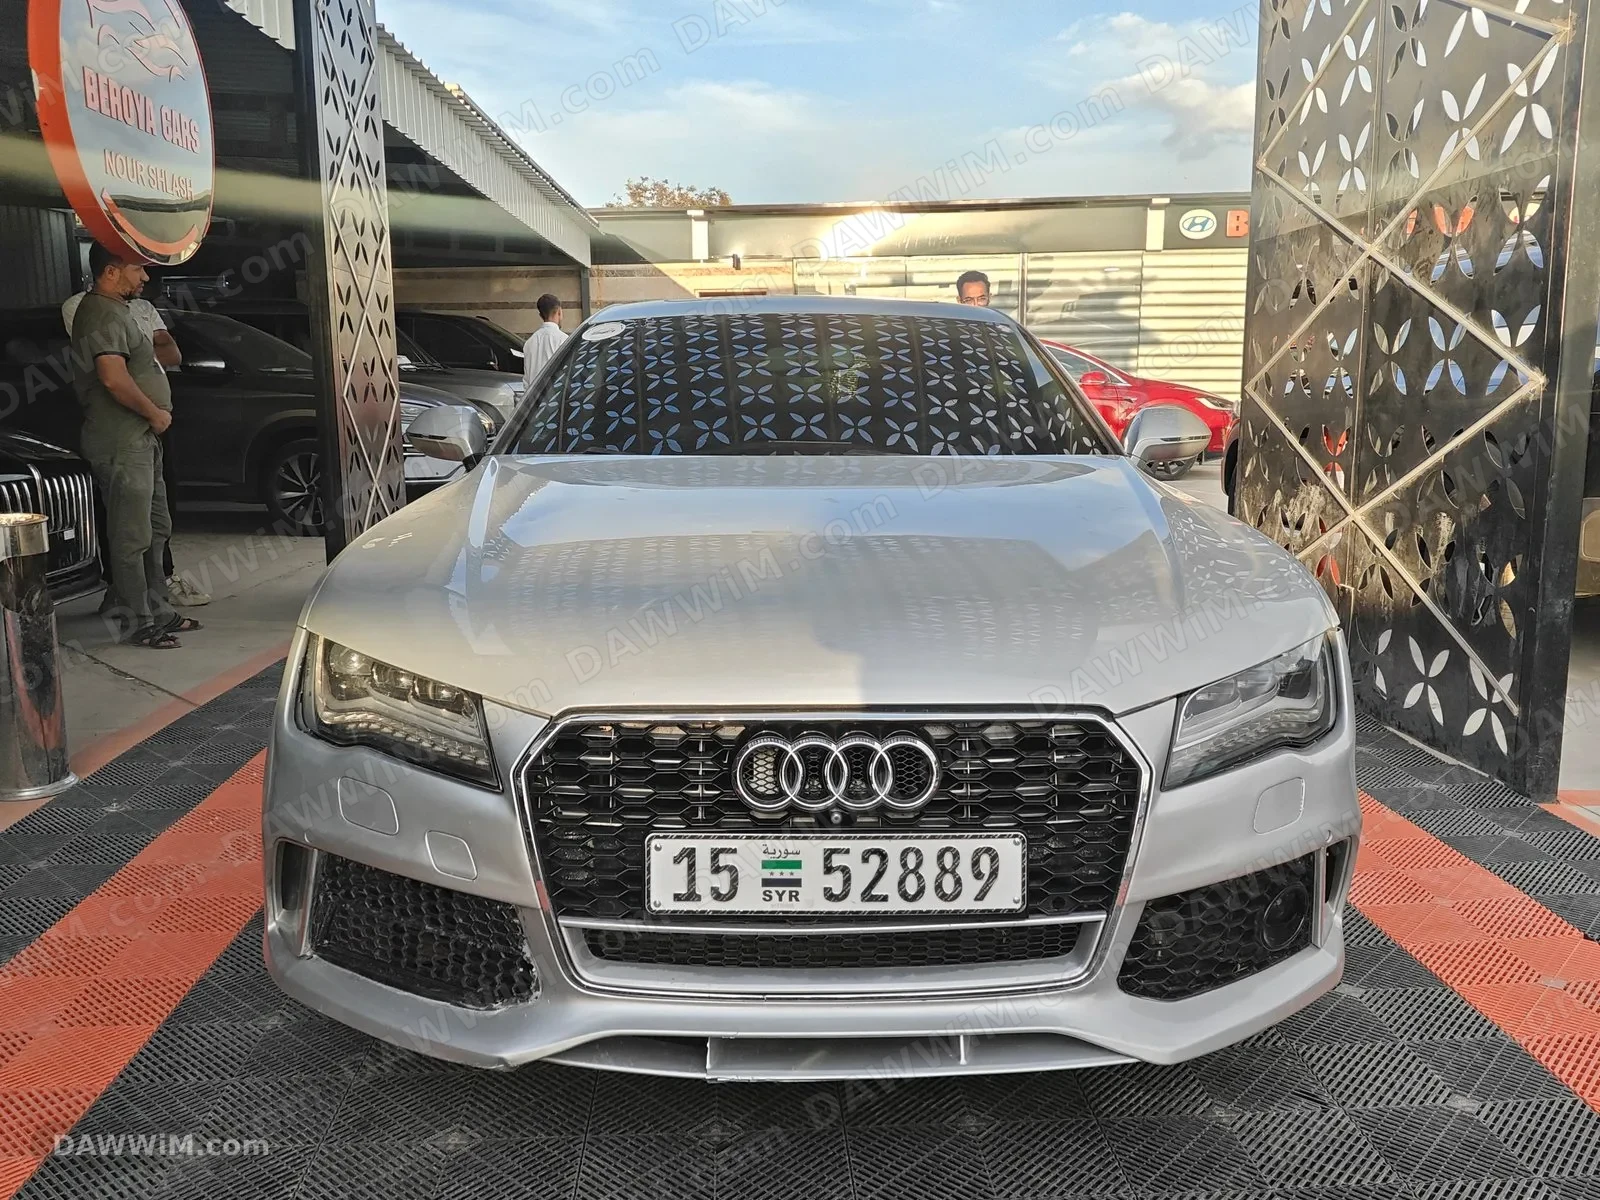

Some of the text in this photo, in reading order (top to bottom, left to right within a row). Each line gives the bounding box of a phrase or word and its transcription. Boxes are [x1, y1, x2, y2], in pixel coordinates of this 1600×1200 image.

[82, 65, 200, 154] BEROYA CARS
[103, 148, 194, 201] NOUR SHLASH
[672, 846, 1000, 903] 15 52889
[762, 843, 801, 859] سورية
[762, 889, 800, 903] SYR
